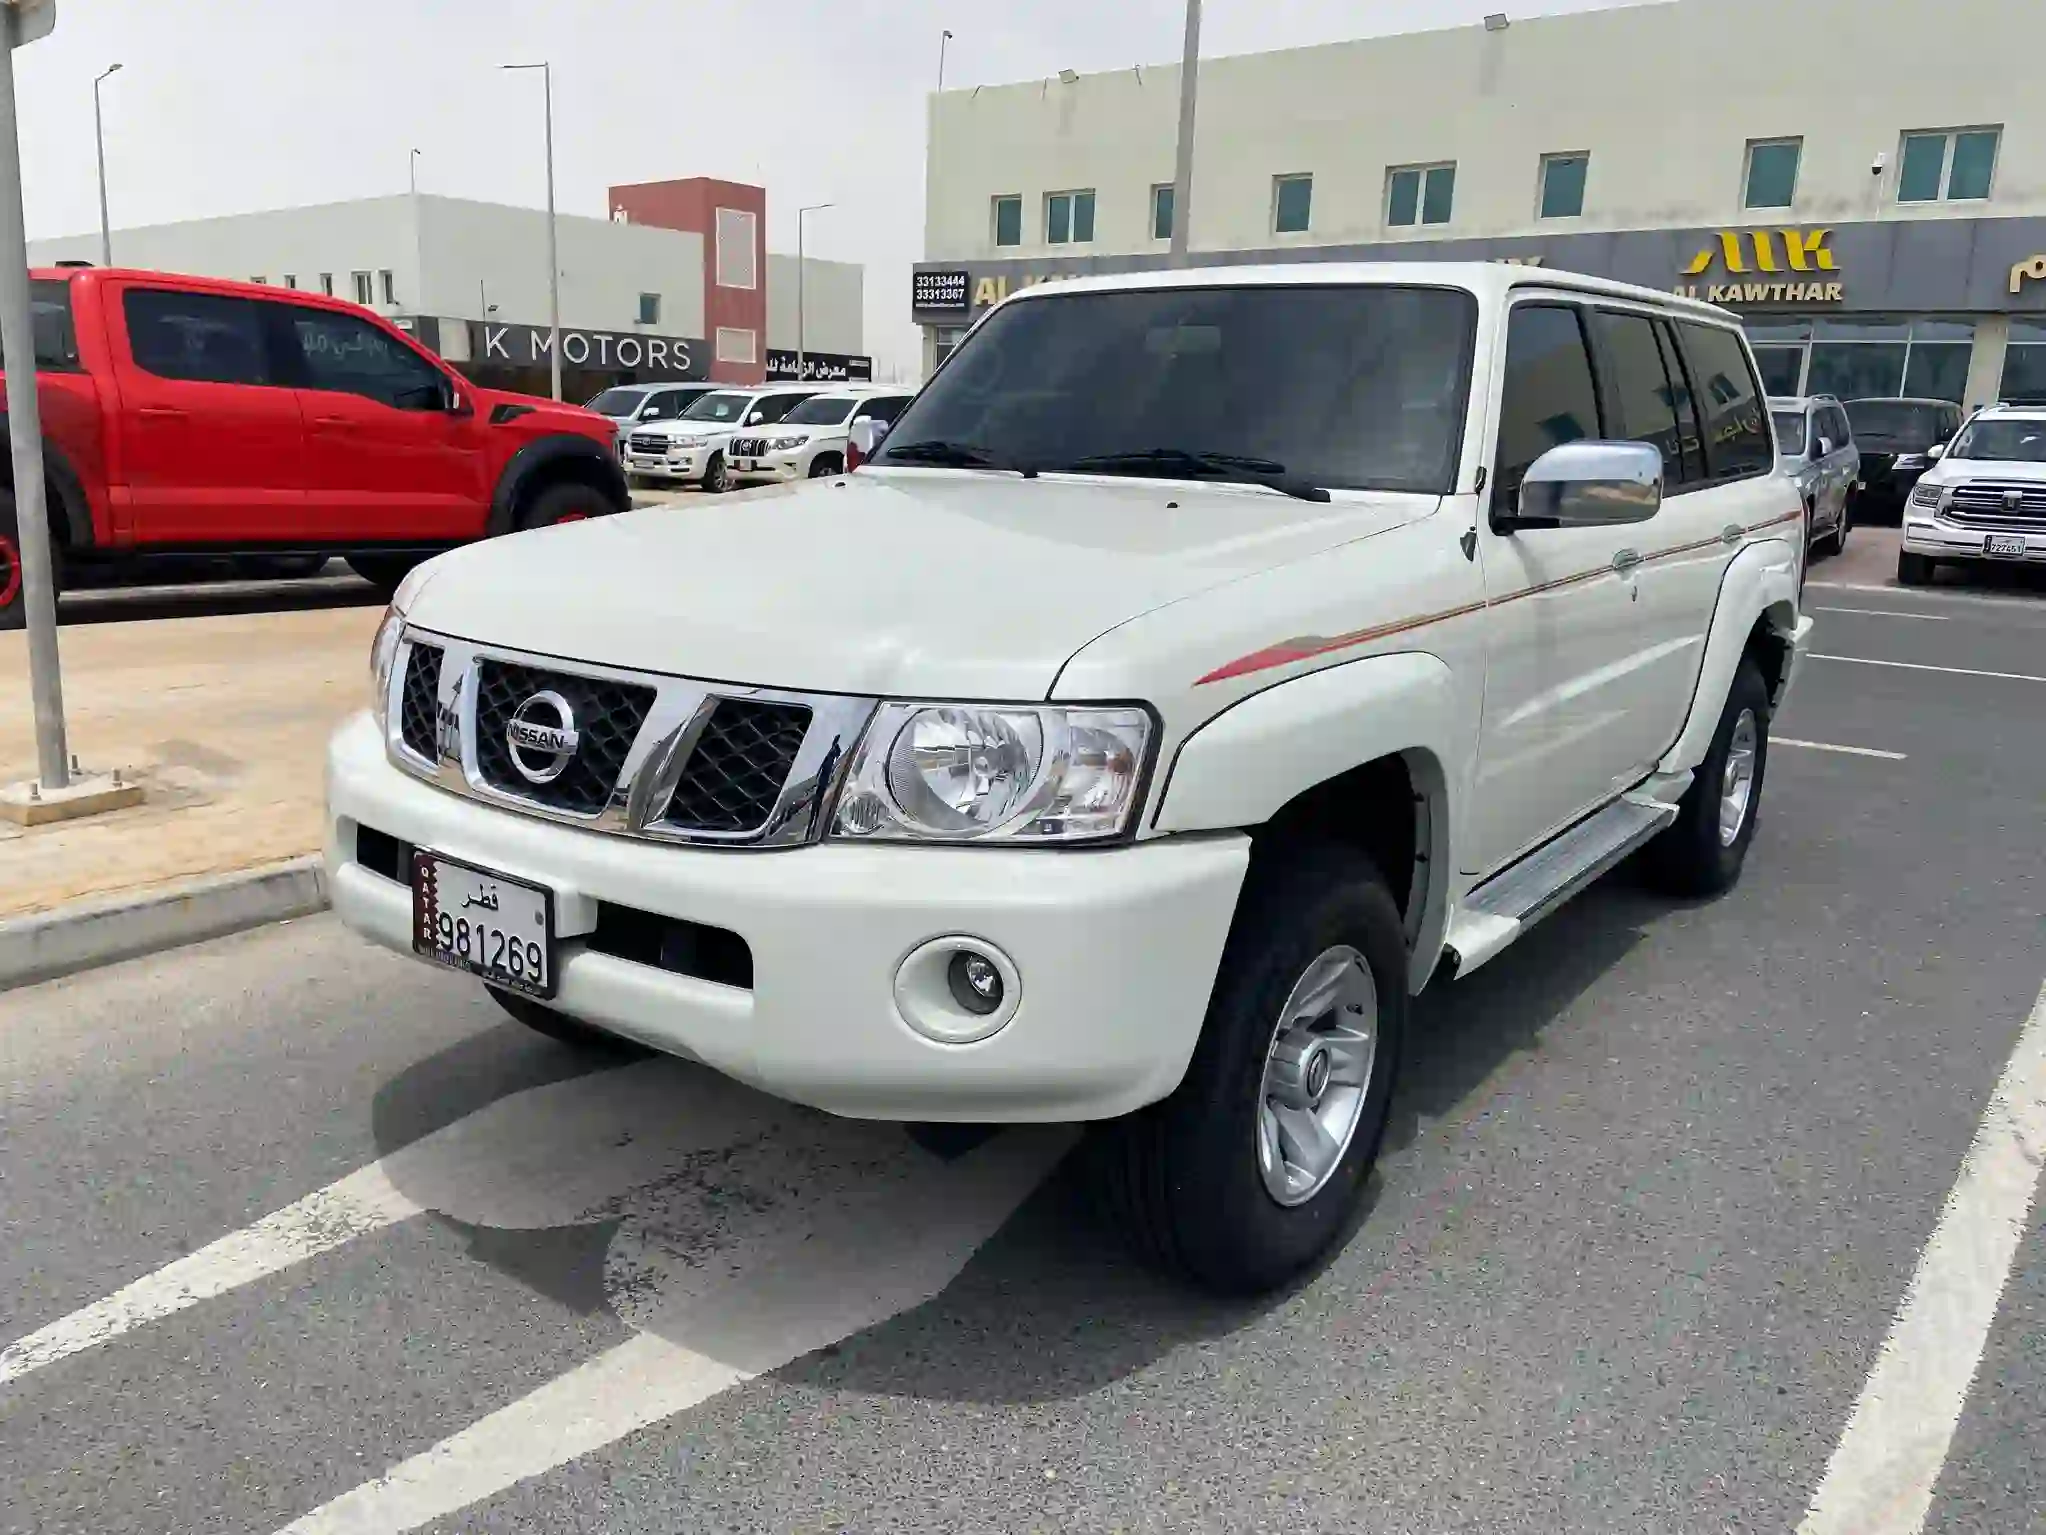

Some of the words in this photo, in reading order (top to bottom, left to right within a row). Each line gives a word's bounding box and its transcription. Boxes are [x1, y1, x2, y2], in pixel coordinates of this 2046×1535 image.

[1707, 282, 1845, 302] KAWTHAR
[485, 326, 510, 359] K
[531, 329, 691, 370] MOTORS
[815, 361, 846, 380] معرض
[508, 722, 565, 748] NISSAN
[420, 866, 432, 940] QATAR
[461, 883, 499, 911] قطر
[439, 911, 543, 984] 981269
